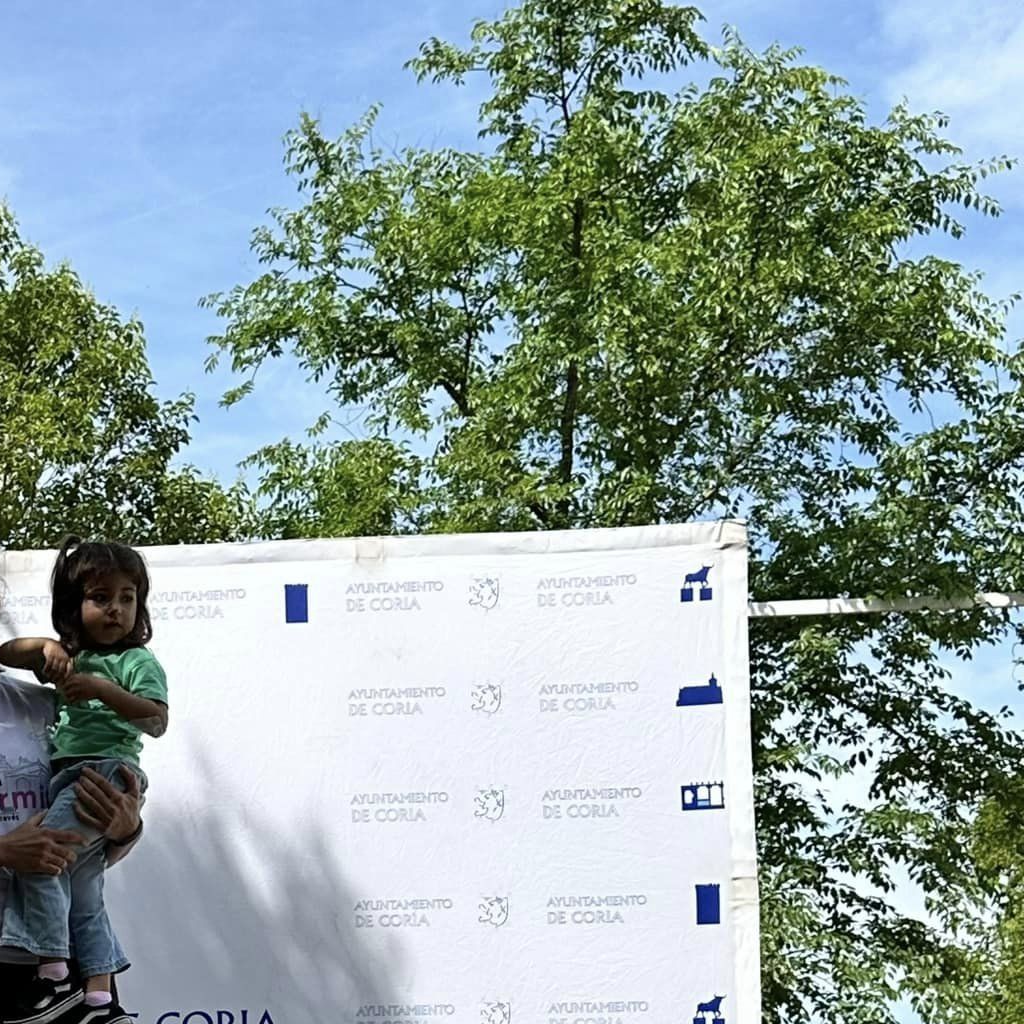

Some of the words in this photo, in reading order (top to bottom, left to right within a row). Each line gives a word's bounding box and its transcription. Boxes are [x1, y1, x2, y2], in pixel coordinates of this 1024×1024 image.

[345, 580, 445, 594] AYUNTAMIENTO
[536, 574, 637, 589] AYUNTAMIENTO
[346, 598, 365, 612] DE
[369, 597, 421, 611] CORIA
[537, 593, 556, 607] DE
[561, 591, 614, 606] CORIA
[150, 607, 169, 620] DE
[174, 605, 225, 619] CORIA
[348, 686, 447, 699] AYUNTAMIENTO
[538, 681, 639, 695] AYUNTAMIENTO
[348, 703, 368, 717] DE
[371, 702, 423, 716] CORIA
[539, 698, 559, 712] DE
[562, 697, 616, 711] CORIA
[350, 792, 449, 805] AYUNTAMIENTO
[541, 787, 642, 801] AYUNTAMIENTO
[351, 809, 371, 823] DE
[374, 808, 427, 822] CORIA
[542, 805, 562, 819] DE
[566, 803, 620, 818] CORIA
[353, 898, 454, 912] AYUNTAMIENTO
[546, 894, 648, 908] AYUNTAMIENTO
[355, 914, 374, 928] DE
[378, 913, 430, 927] CORIA
[546, 911, 567, 925] DE
[571, 910, 625, 924] CORIA
[355, 1004, 455, 1017] AYUNTAMIENTO
[548, 1001, 649, 1014] AYUNTAMIENTO
